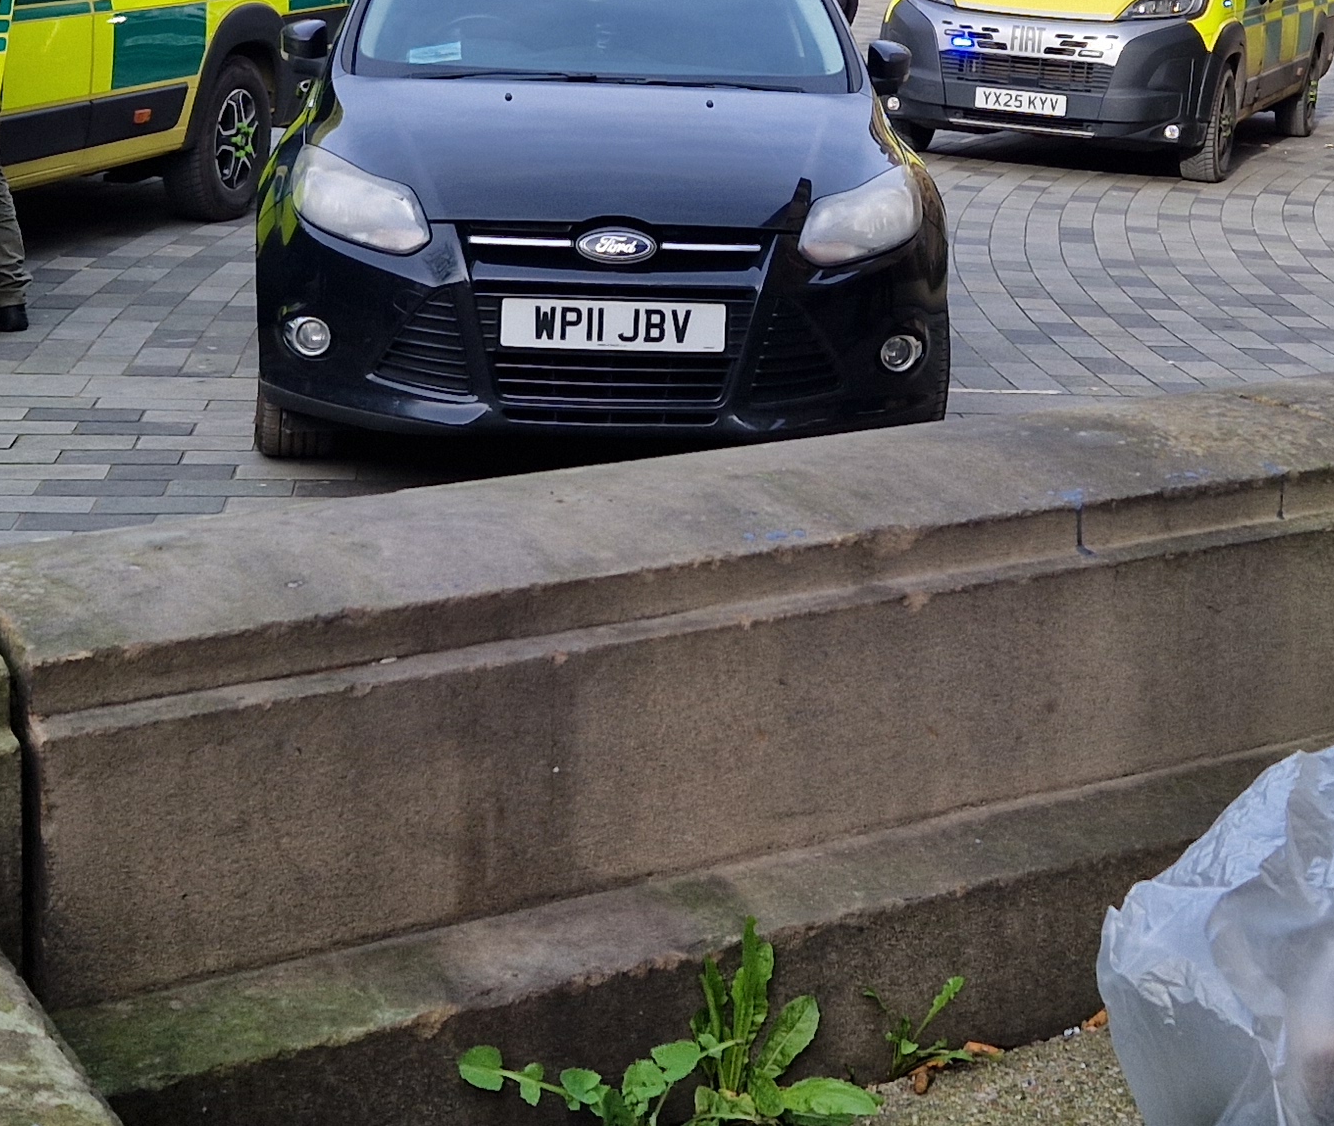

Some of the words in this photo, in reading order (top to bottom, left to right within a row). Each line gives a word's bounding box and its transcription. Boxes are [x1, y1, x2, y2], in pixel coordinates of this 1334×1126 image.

[1010, 24, 1046, 54] FIAT
[983, 91, 1023, 109] YX25
[1028, 96, 1059, 112] KYV
[595, 235, 637, 254] Ford
[535, 305, 605, 342] WP11
[618, 308, 692, 344] JBV
